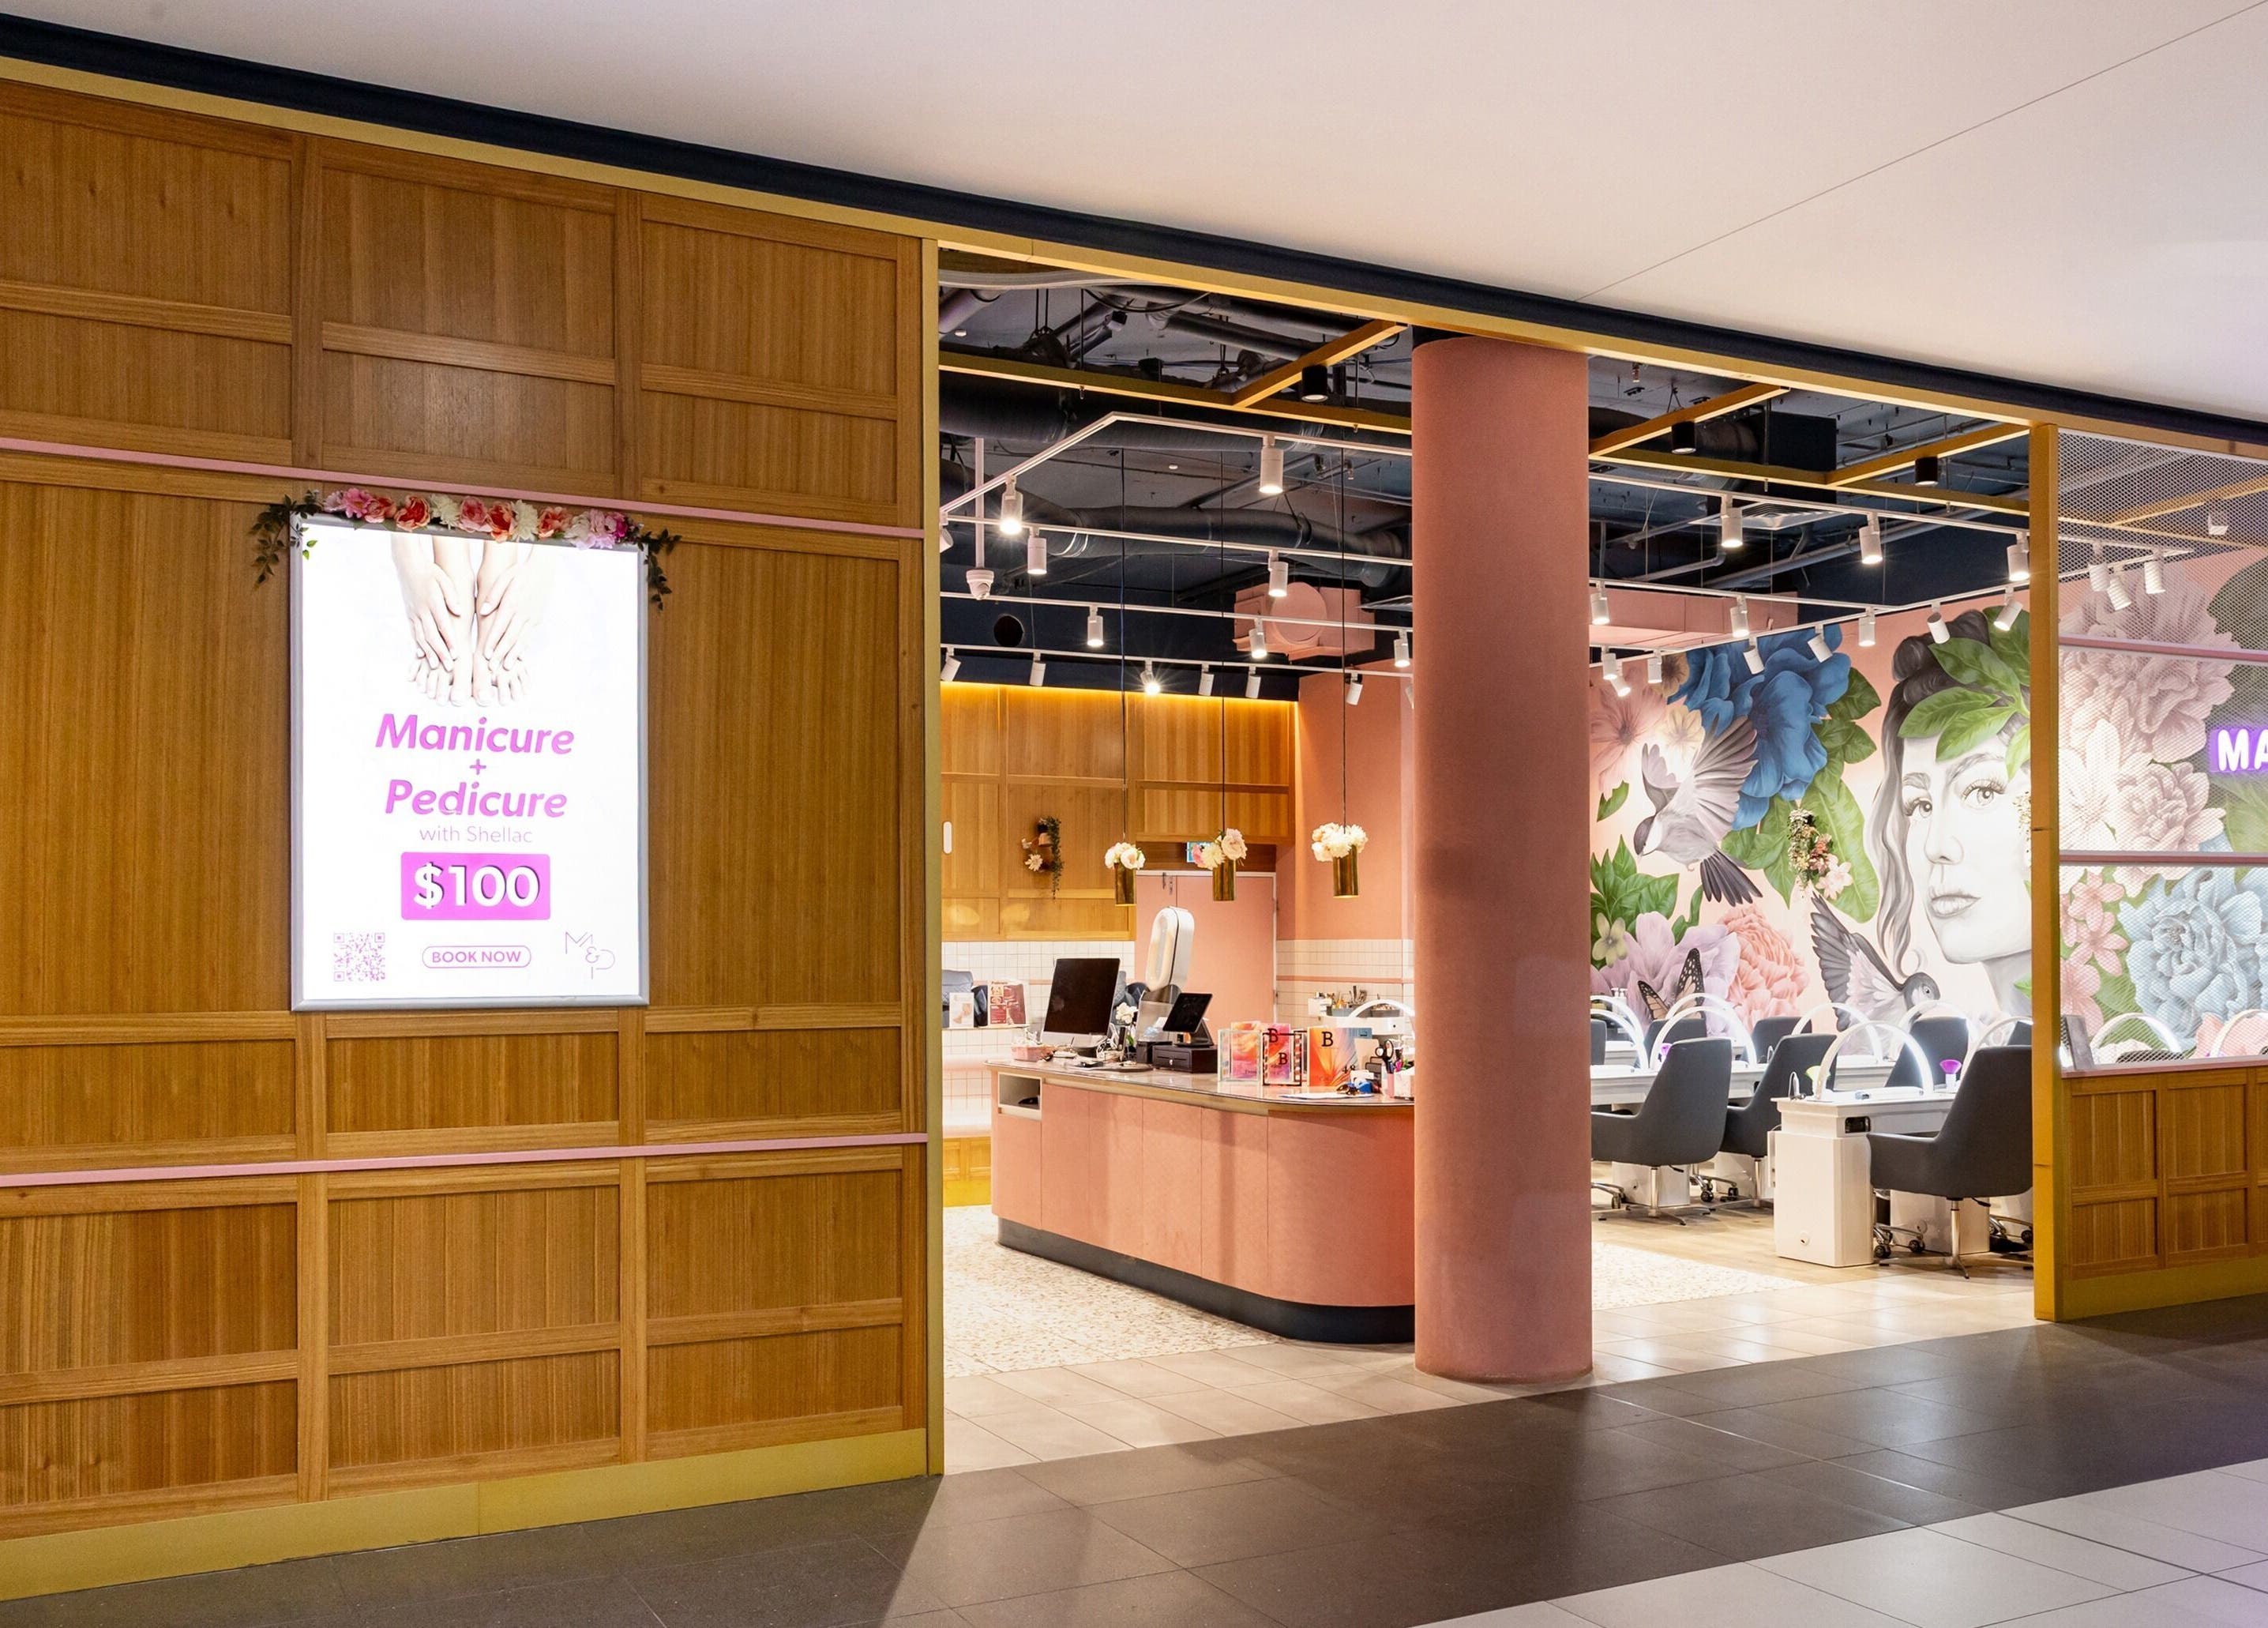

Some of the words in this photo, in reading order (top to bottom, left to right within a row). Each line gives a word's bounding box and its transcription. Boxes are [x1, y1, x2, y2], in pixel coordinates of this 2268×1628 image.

[375, 713, 575, 754] Manicure
[469, 758, 487, 776] +
[385, 779, 568, 818] Pedicure
[419, 825, 461, 842] with
[467, 825, 534, 844] Shellac
[413, 861, 541, 910] $100
[431, 951, 478, 964] BOOK
[480, 950, 522, 963] NOW
[1321, 1031, 1335, 1047] B
[1278, 1052, 1289, 1066] B
